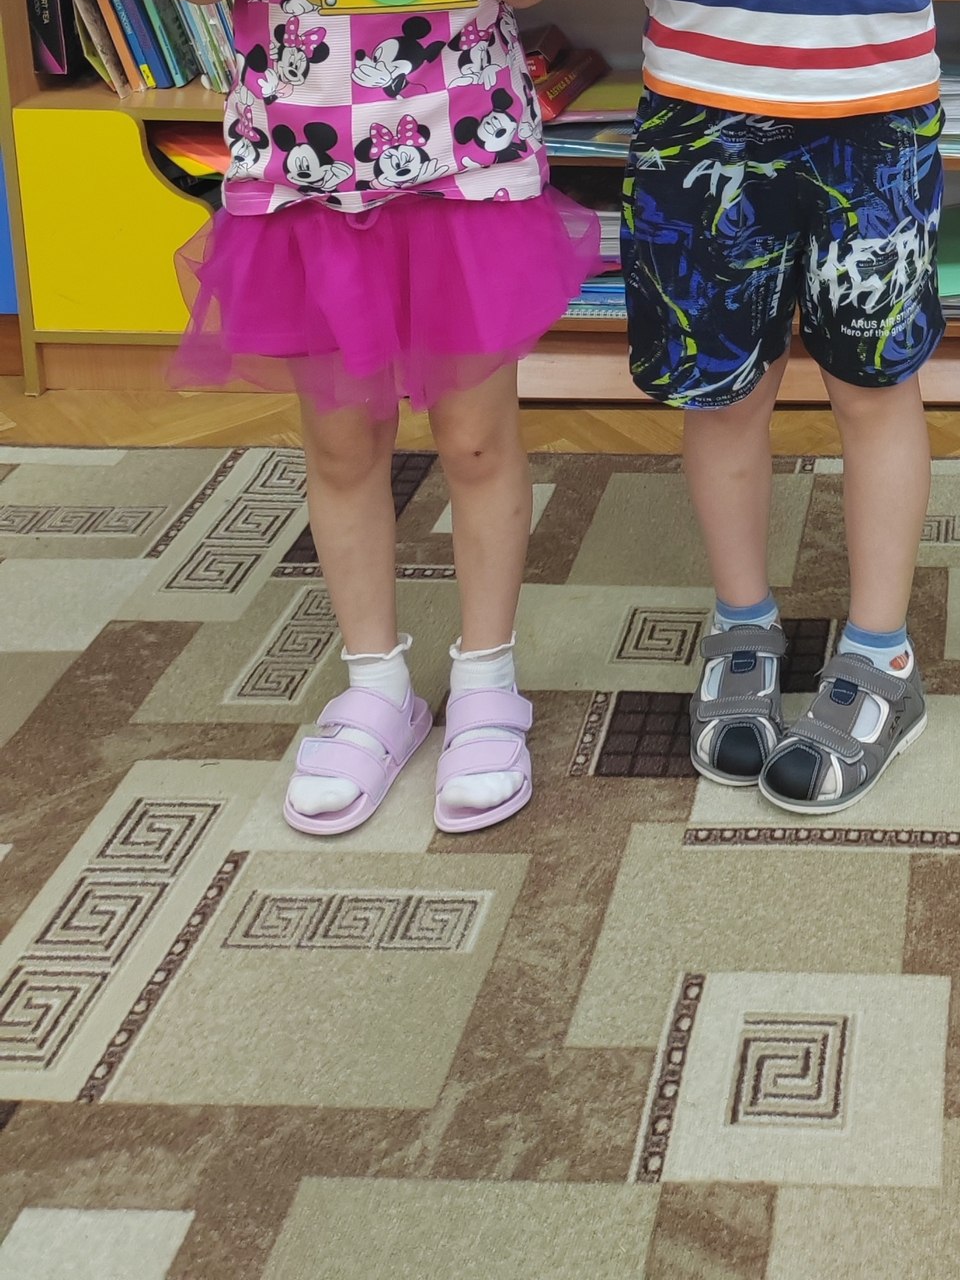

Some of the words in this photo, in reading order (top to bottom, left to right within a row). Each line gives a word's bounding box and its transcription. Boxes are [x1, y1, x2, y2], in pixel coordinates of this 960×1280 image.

[42, 9, 50, 25] TEA
[850, 318, 878, 329] ARUS
[841, 324, 862, 337] Hero
[863, 328, 874, 338] of
[875, 328, 890, 337] the
